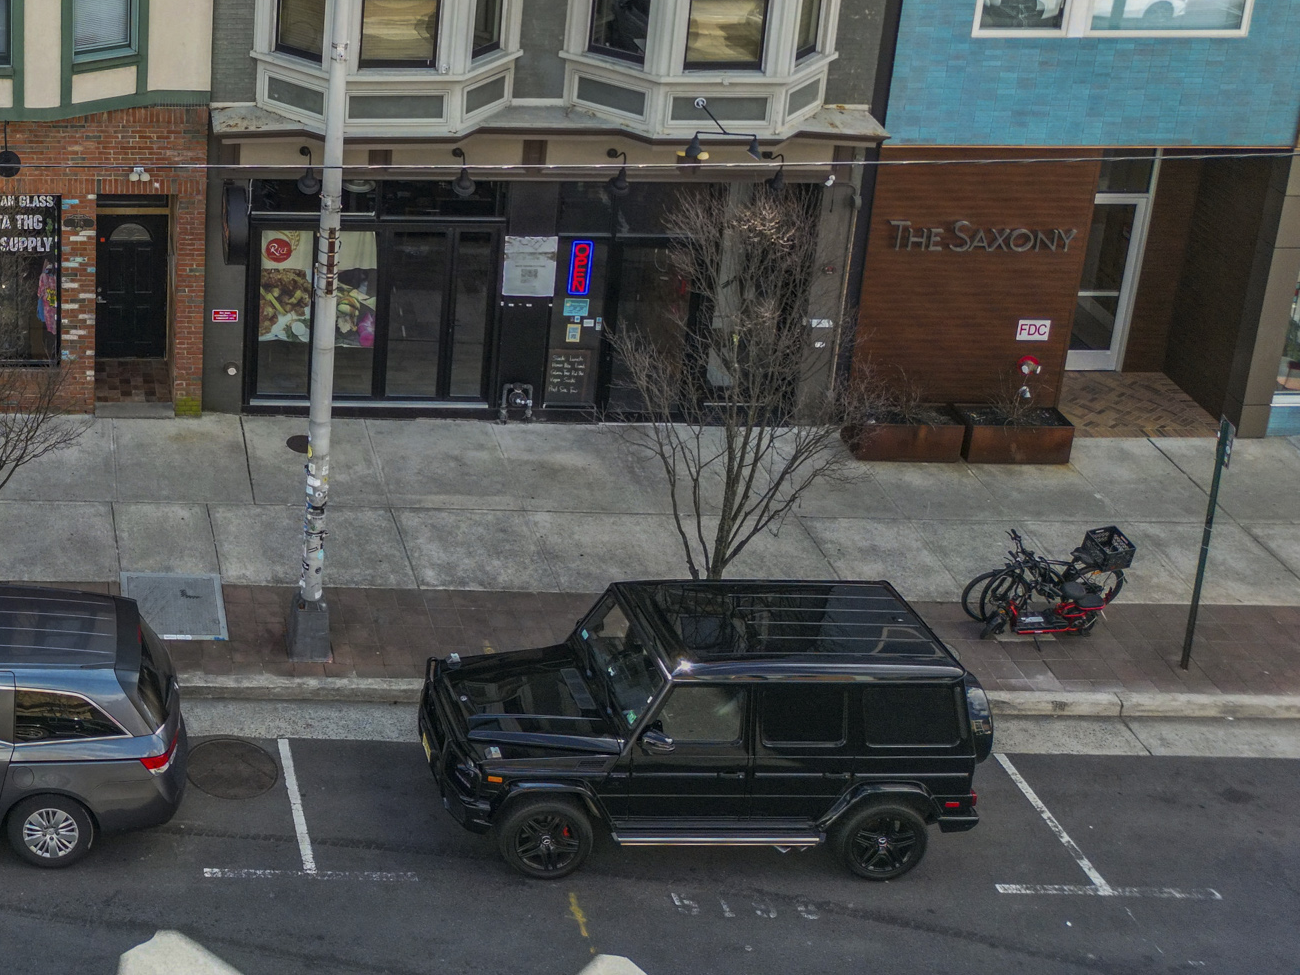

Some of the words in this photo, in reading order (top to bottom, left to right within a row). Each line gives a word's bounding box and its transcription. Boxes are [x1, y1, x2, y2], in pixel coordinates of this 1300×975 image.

[19, 195, 54, 207] GLASS
[15, 214, 43, 230] THC
[889, 220, 945, 252] THE
[949, 220, 1078, 253] SAXONY
[0, 237, 53, 252] SUPPLY
[571, 243, 590, 293] OPEN
[1018, 323, 1048, 337] FDC
